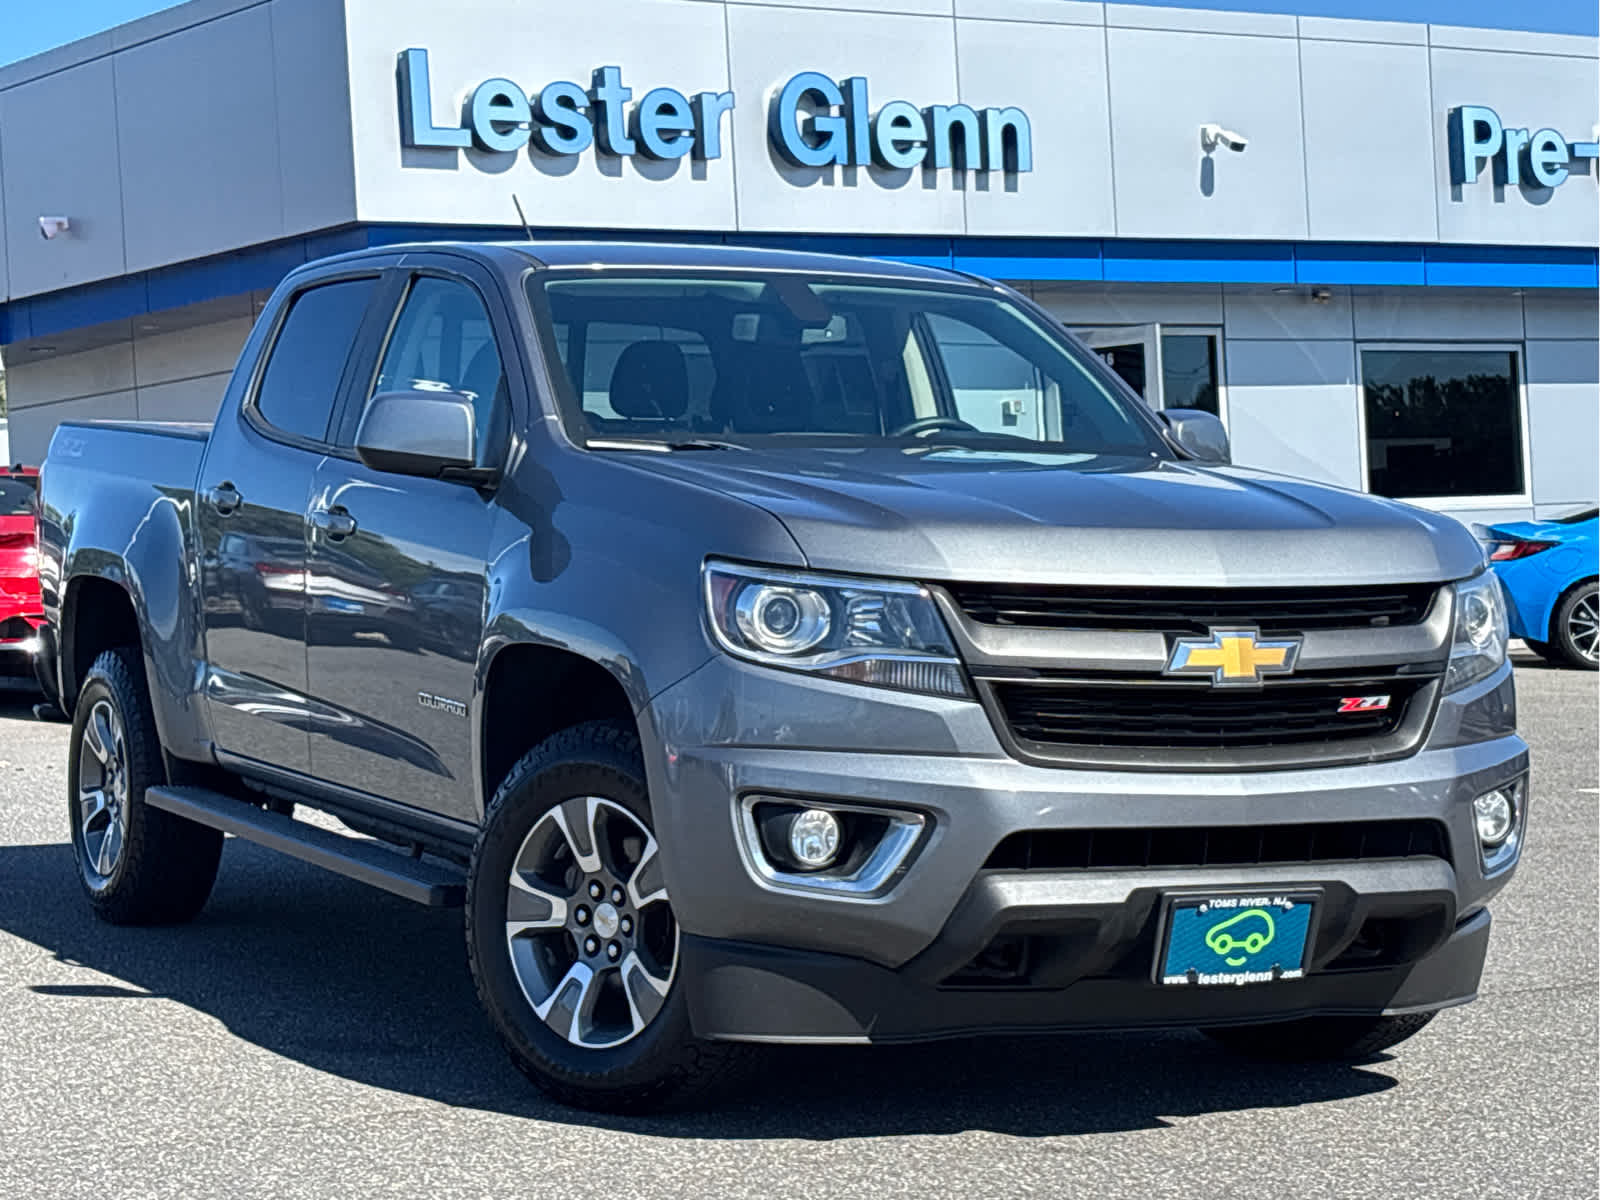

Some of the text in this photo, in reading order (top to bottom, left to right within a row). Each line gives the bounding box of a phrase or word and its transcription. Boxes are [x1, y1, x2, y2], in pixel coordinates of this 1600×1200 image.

[397, 48, 1033, 173] Lester Glenn
[1449, 105, 1599, 188] Pre-
[417, 691, 466, 717] COLORADO
[1337, 695, 1391, 712] Z71
[1209, 899, 1237, 908] TOMS
